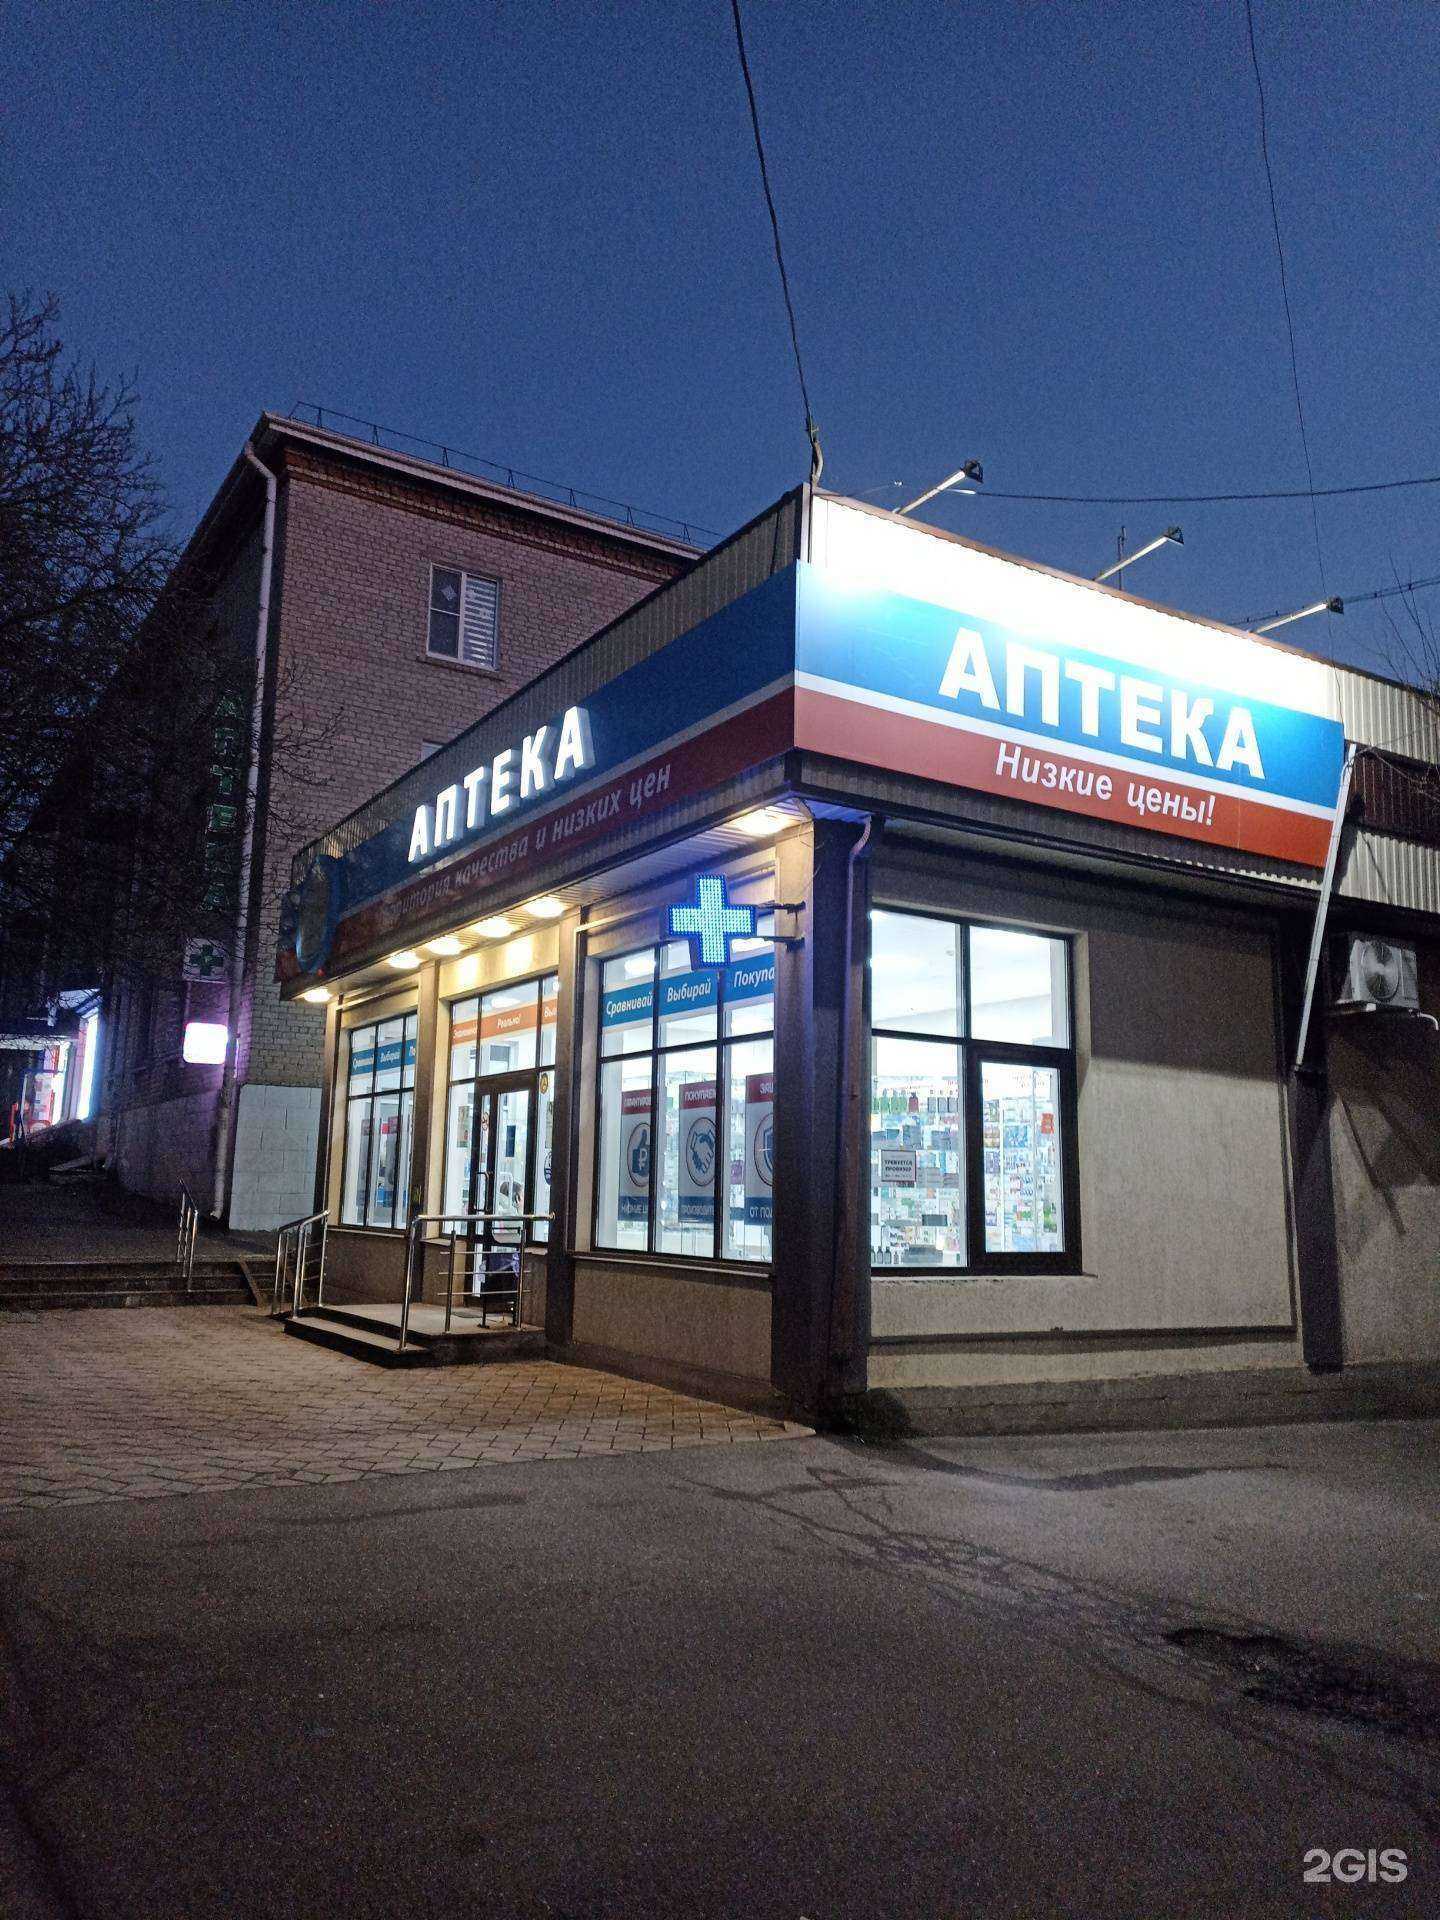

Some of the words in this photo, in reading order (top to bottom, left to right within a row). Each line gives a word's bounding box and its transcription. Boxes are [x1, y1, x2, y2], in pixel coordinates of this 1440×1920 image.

[938, 626, 1266, 780] АПТЕКА
[408, 706, 594, 862] АПТЕКА
[455, 836, 528, 888] качества
[536, 826, 546, 850] и
[552, 789, 624, 842] низких
[630, 764, 671, 810] цен
[995, 742, 1113, 801] Низкие
[1127, 780, 1216, 826] цены!
[606, 991, 653, 1017] Сравнивай
[667, 979, 711, 1003] Выбирай
